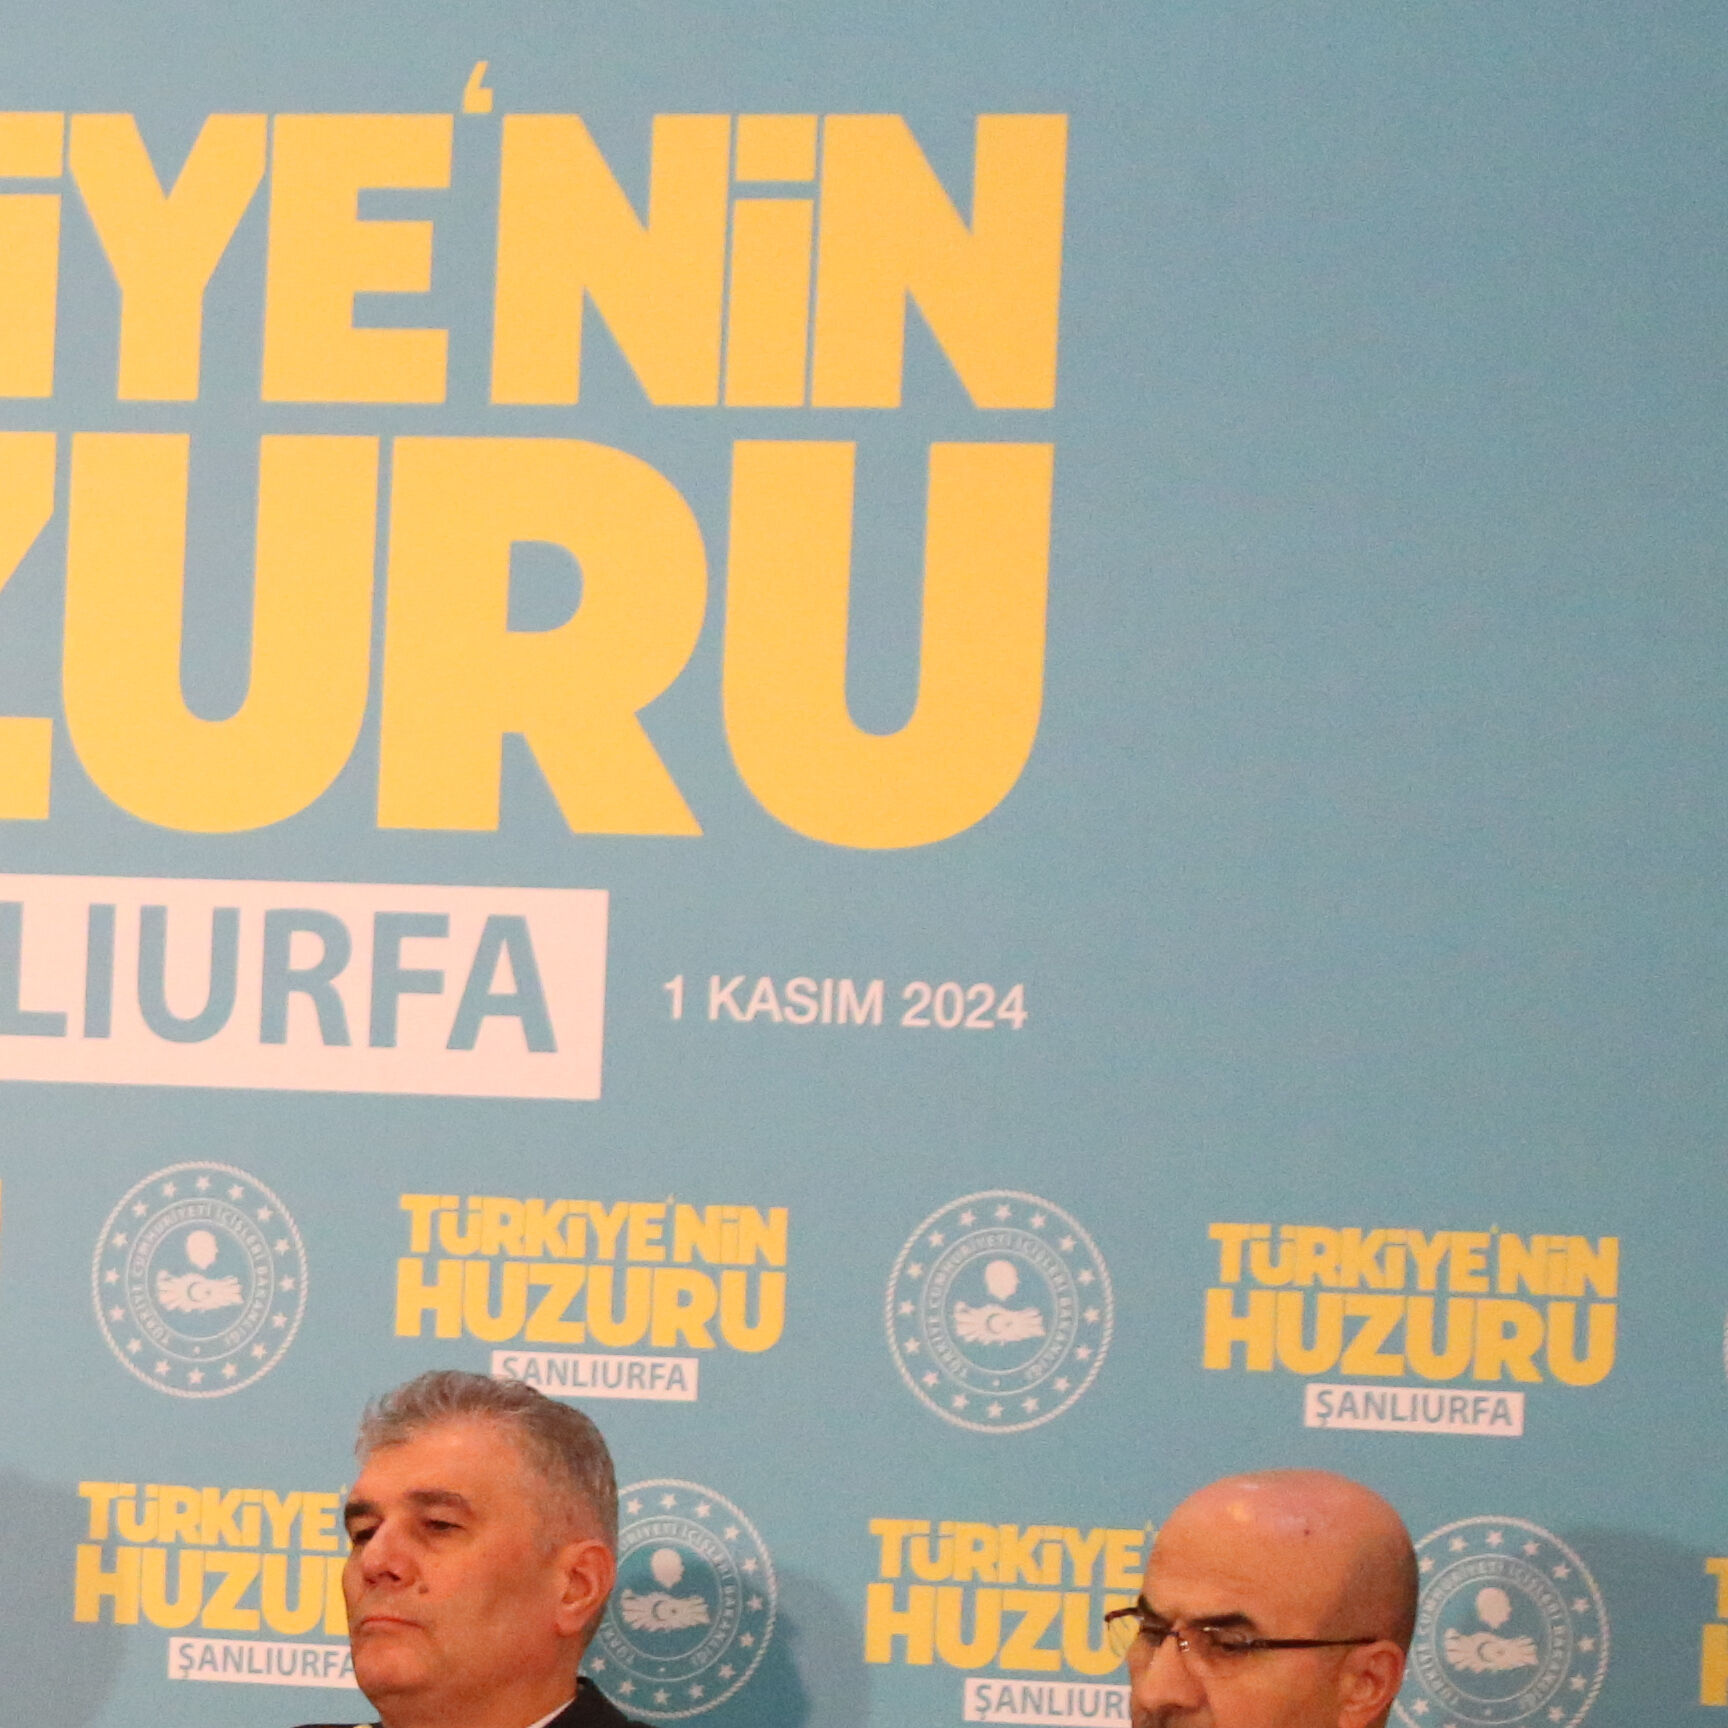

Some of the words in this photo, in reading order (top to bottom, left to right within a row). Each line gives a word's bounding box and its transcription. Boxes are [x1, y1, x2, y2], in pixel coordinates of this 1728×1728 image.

[665, 976, 684, 1020] 1
[710, 977, 884, 1026] KASIM
[902, 982, 1028, 1030] 2024
[394, 1258, 785, 1351] HUZURU
[1202, 1288, 1615, 1385] HUZURU
[1316, 1390, 1513, 1427] ŞANLIURFA
[73, 1544, 346, 1634] HUZU
[866, 1584, 1137, 1675] HUZU
[976, 1684, 1130, 1720] ŞANLIUR
